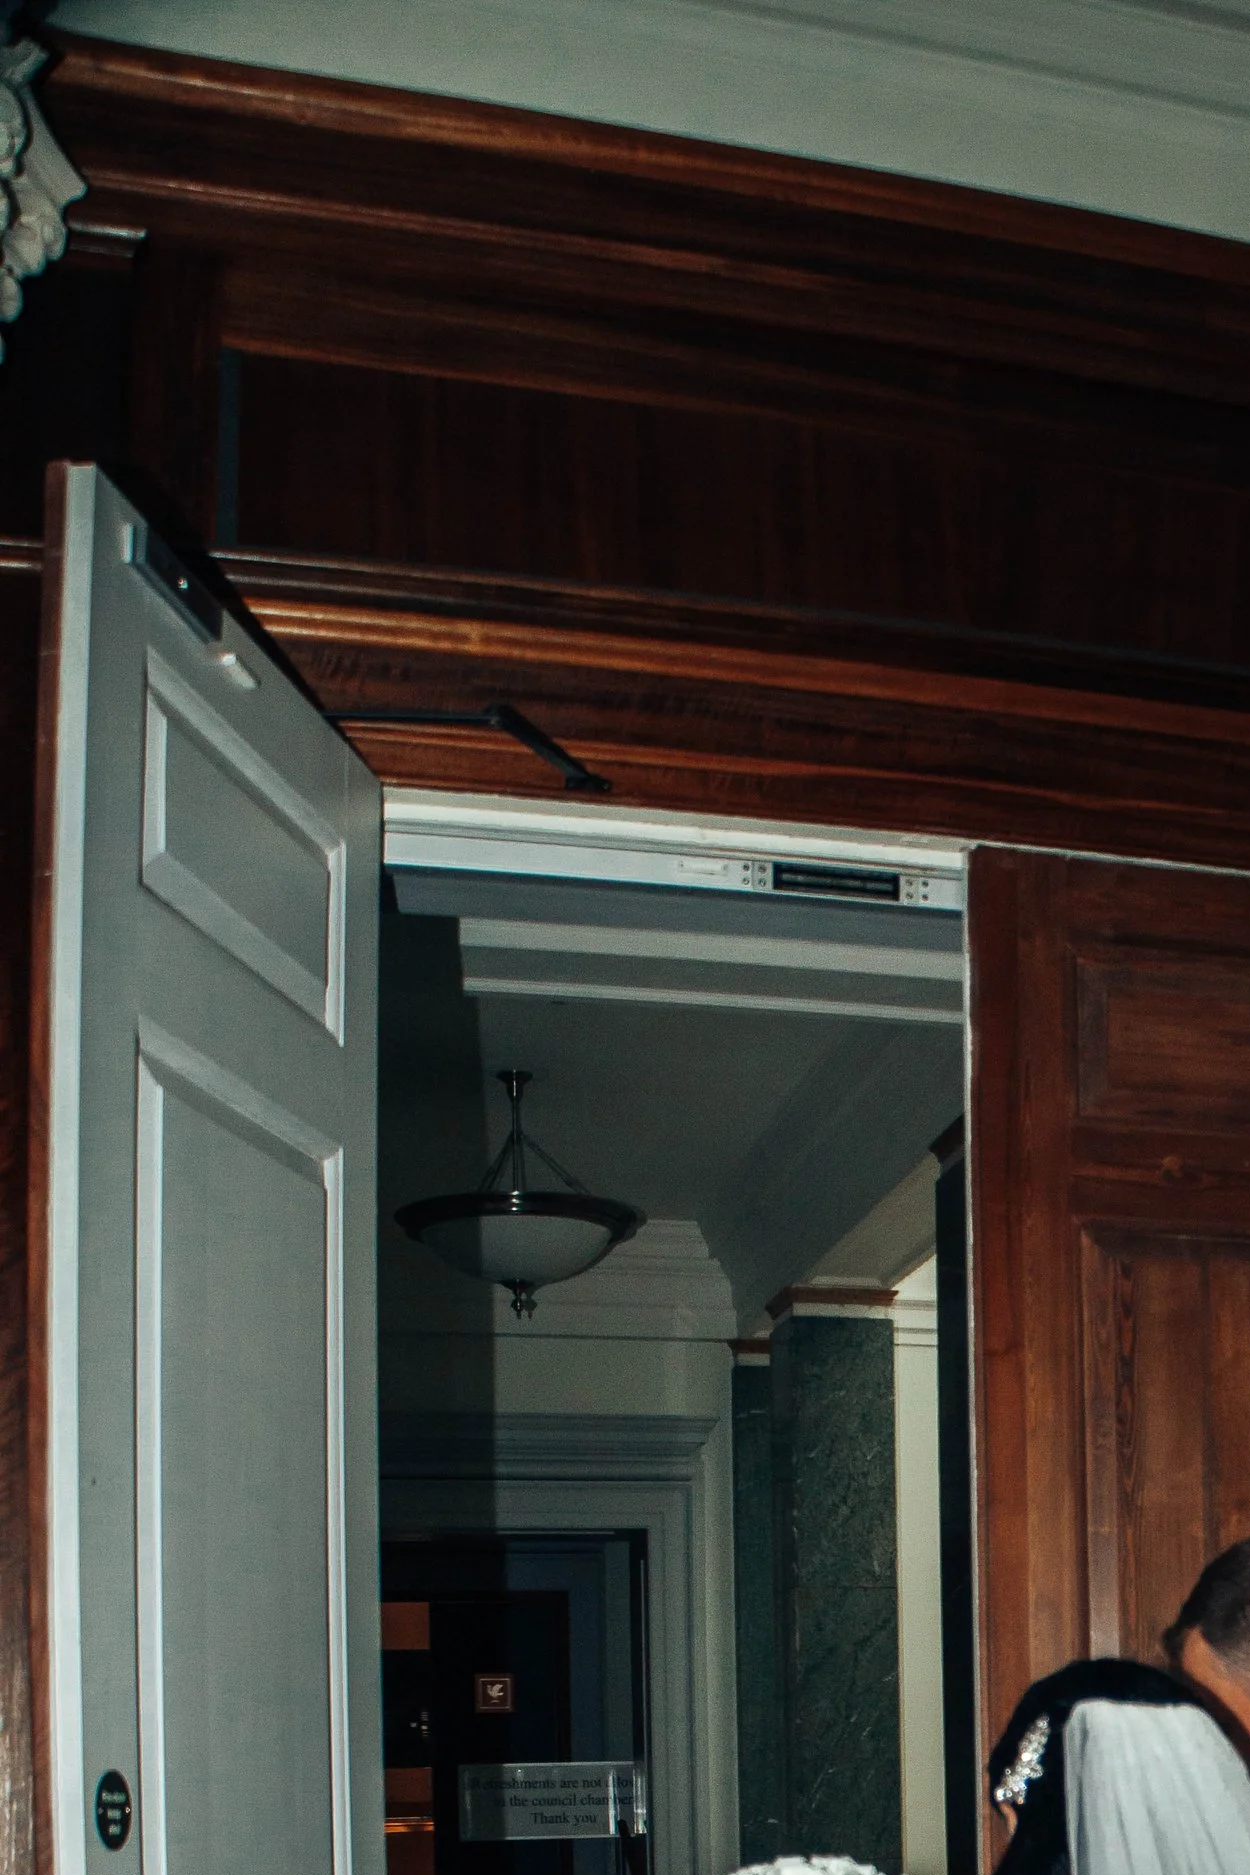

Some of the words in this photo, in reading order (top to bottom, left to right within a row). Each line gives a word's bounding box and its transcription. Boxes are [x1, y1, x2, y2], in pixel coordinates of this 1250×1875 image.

[561, 1779, 579, 1789] are
[583, 1778, 601, 1788] not
[509, 1795, 528, 1807] the
[531, 1794, 576, 1807] council
[530, 1813, 569, 1825] Thank
[574, 1814, 597, 1826] you
